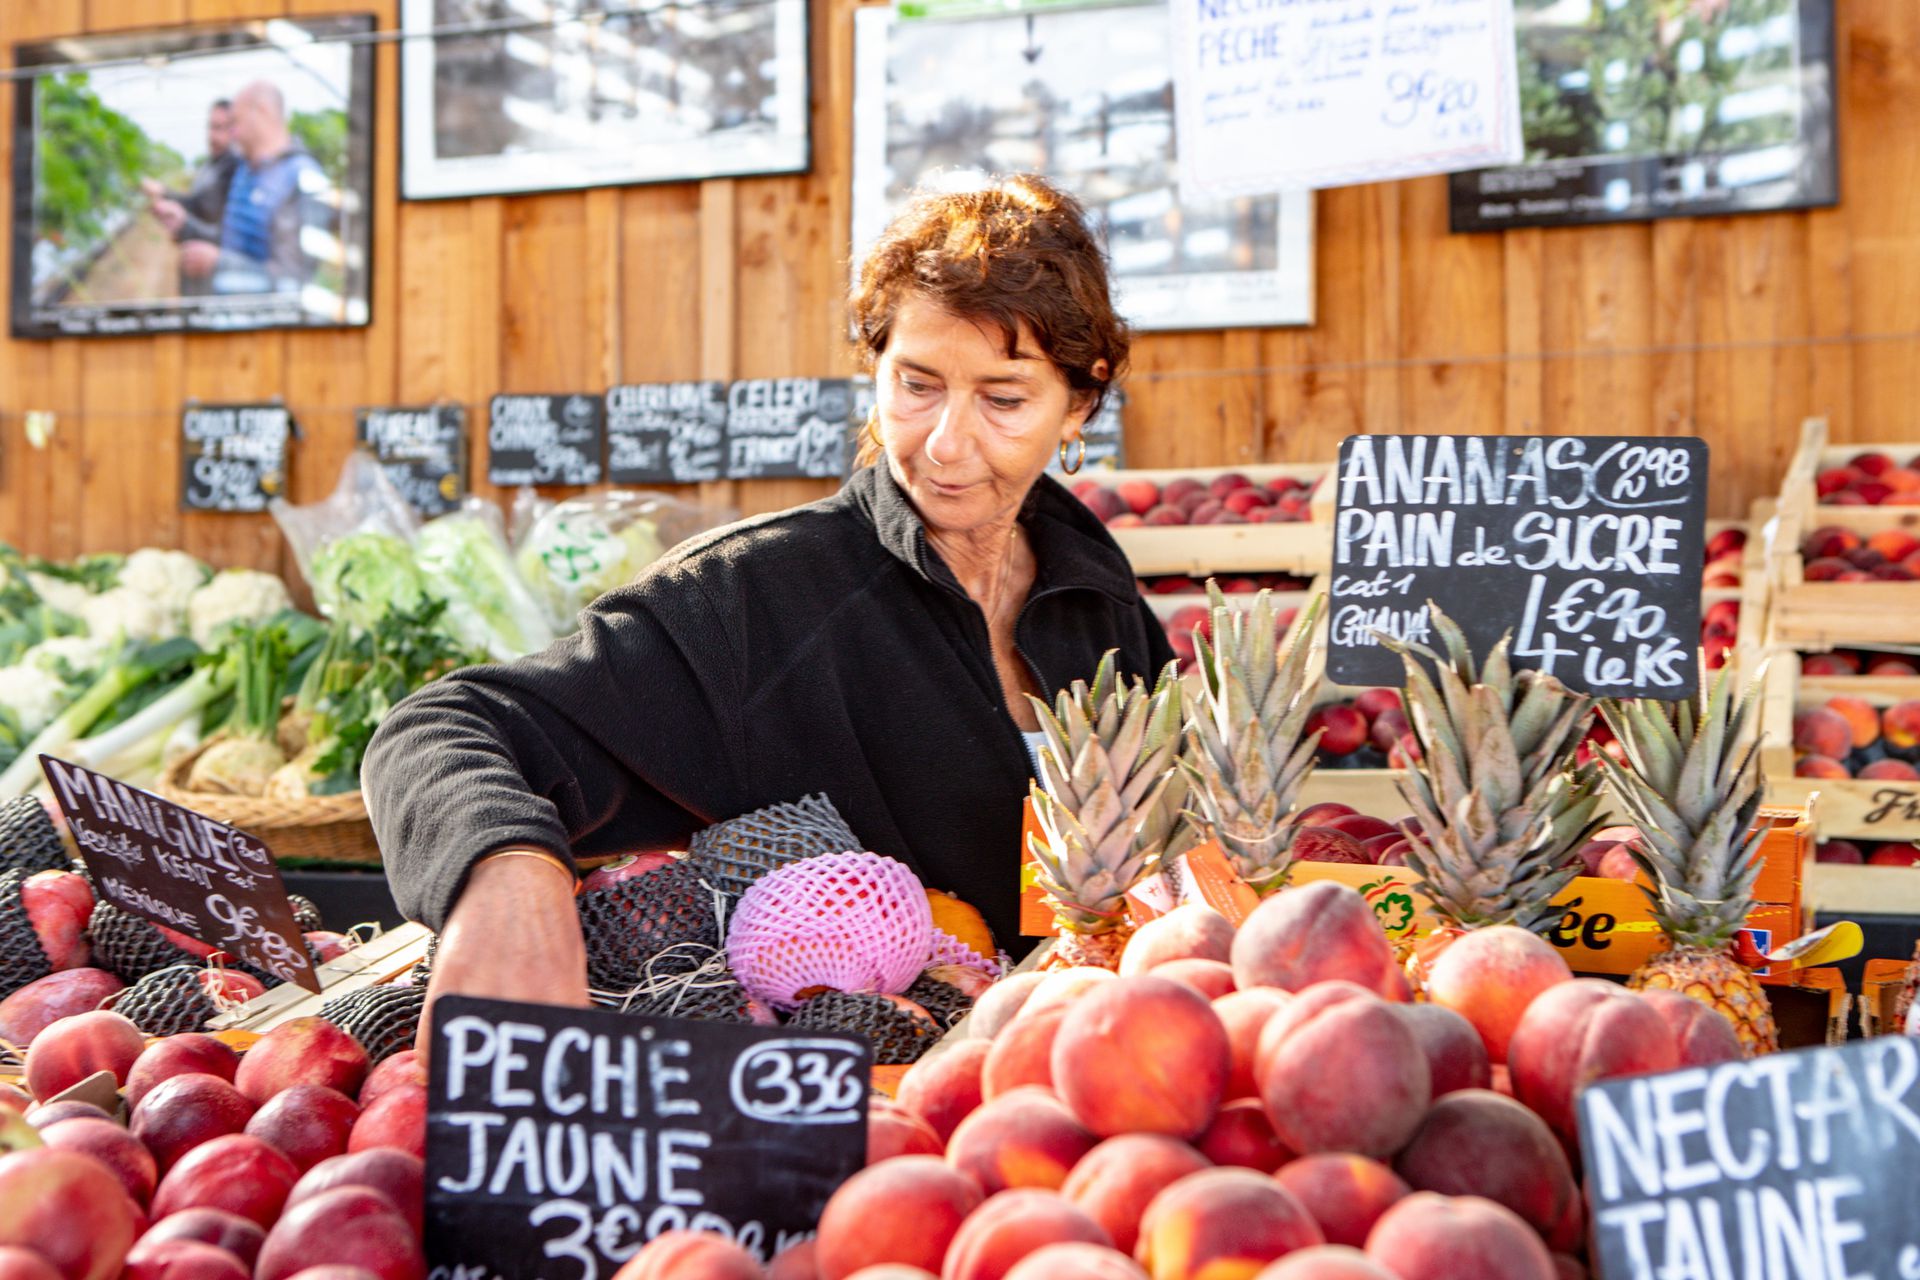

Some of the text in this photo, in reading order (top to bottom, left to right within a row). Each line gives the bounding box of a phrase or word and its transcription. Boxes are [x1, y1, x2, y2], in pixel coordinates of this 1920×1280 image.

[1340, 436, 1592, 509] ANANAS
[1337, 508, 1683, 574] PAIN de SUCRE
[1332, 570, 1391, 597] cat
[50, 760, 240, 871] MANGUE
[152, 845, 218, 890] KENT
[442, 1015, 863, 1118] PECHE 336
[438, 1112, 712, 1208] JAUNE
